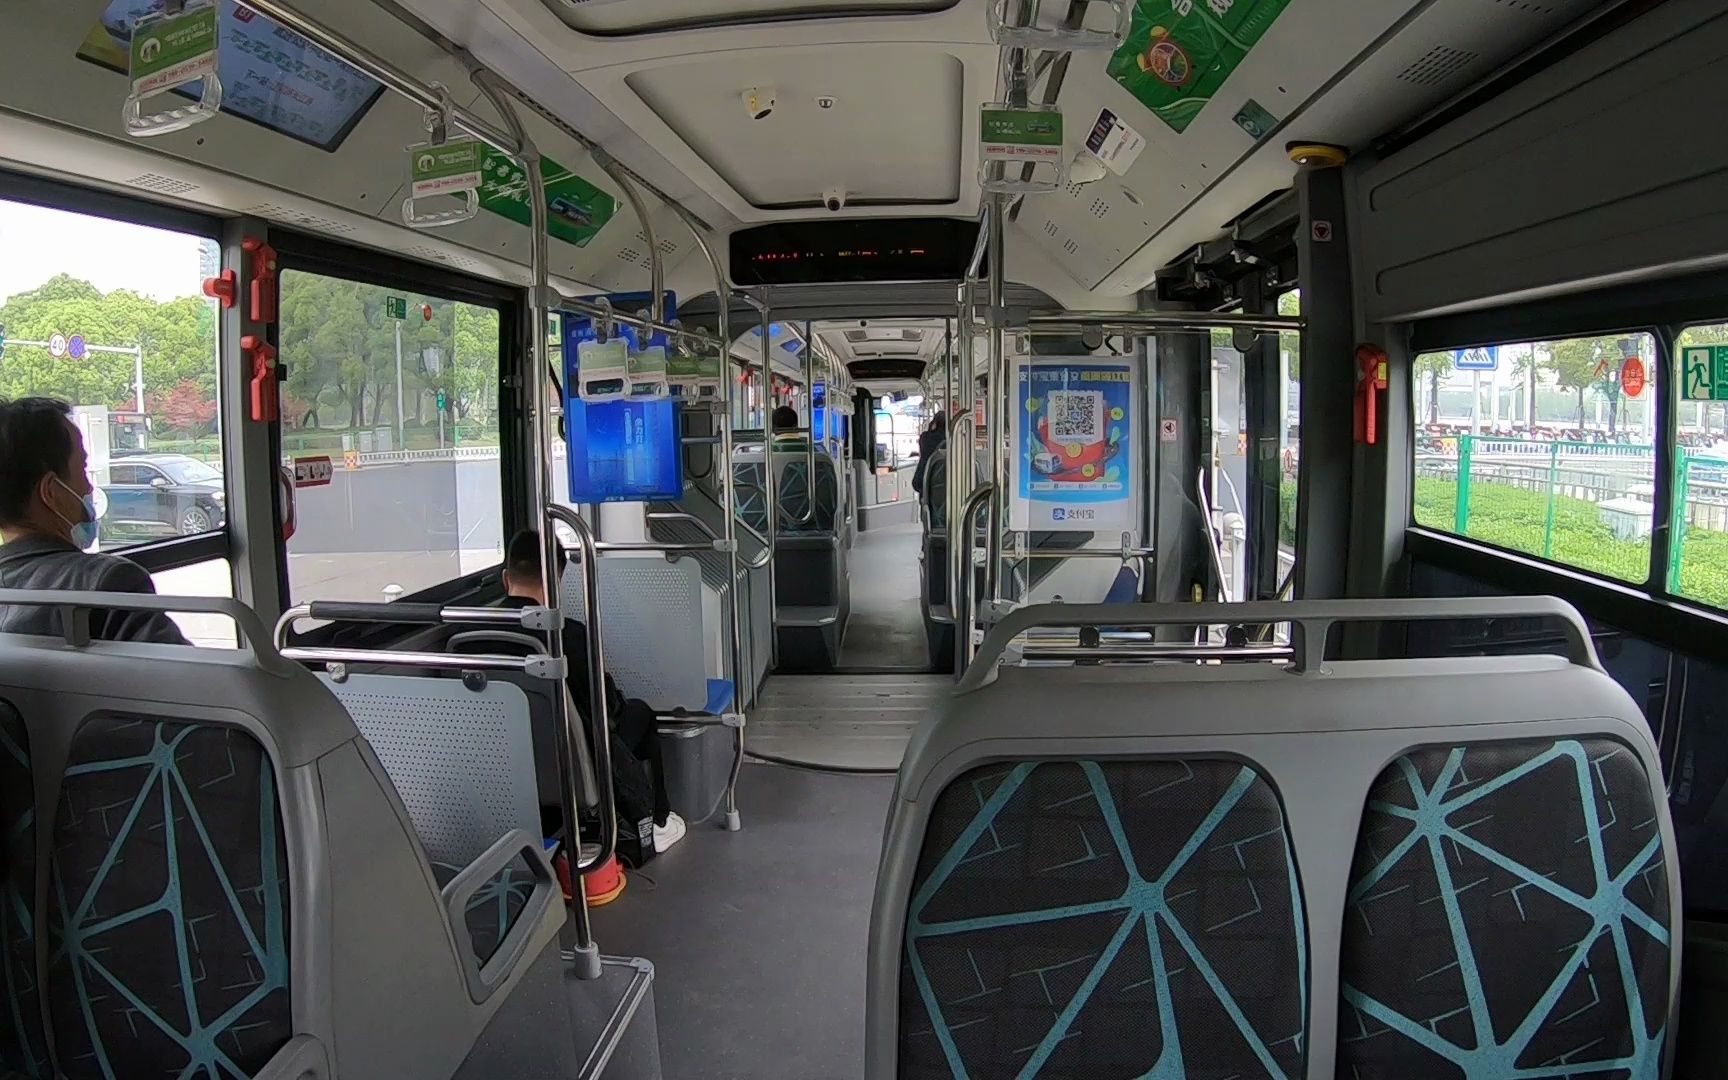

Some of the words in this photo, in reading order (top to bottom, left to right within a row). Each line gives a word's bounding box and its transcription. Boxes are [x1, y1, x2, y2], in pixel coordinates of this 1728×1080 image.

[52, 339, 64, 351] 40
[1067, 508, 1095, 520] 支付宝
